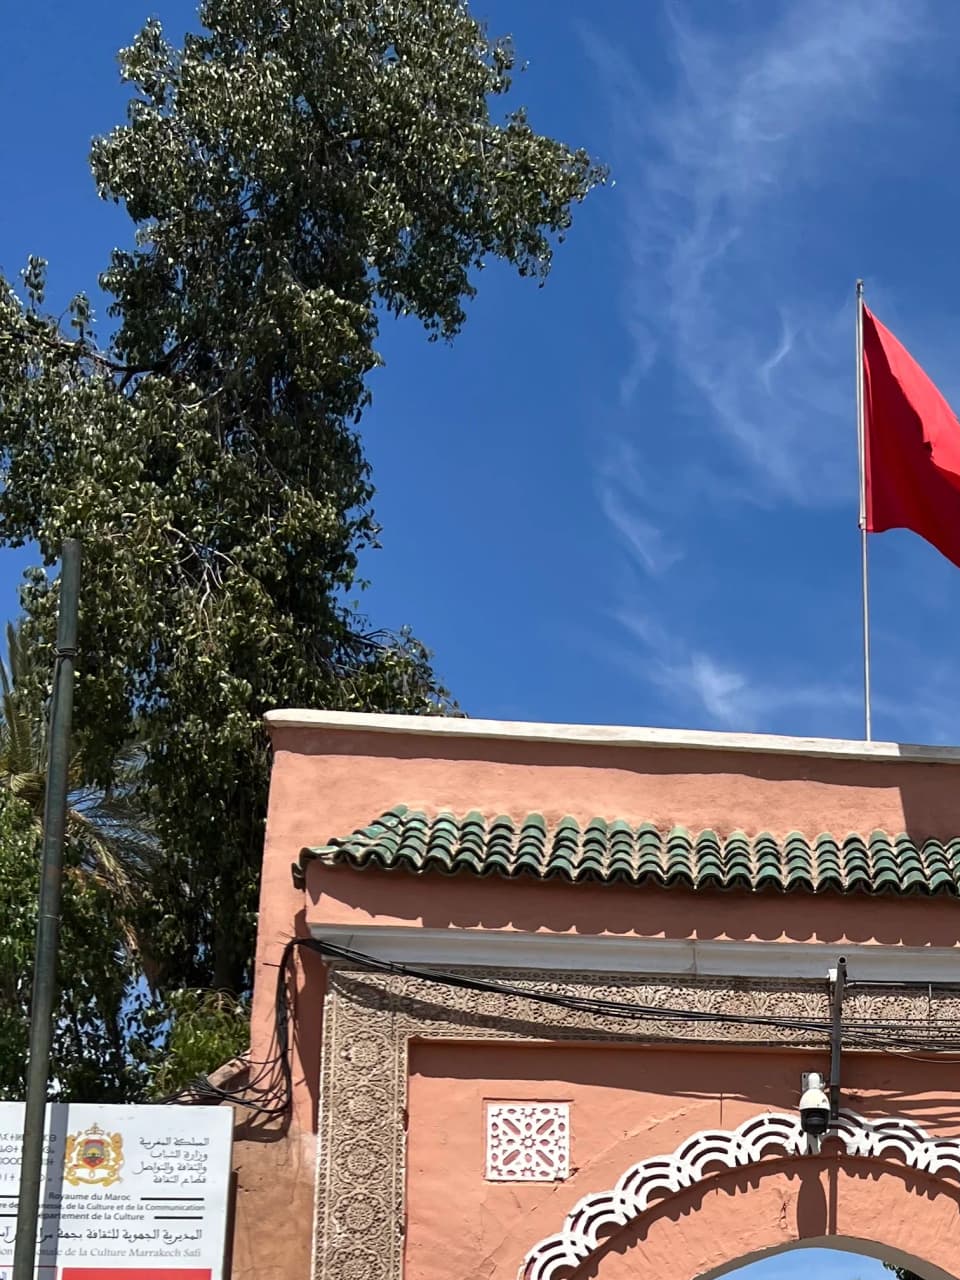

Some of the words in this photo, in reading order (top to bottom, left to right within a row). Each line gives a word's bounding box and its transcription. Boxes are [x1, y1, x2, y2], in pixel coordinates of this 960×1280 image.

[87, 1229, 119, 1239] للثقافة
[123, 1229, 160, 1243] الجهوية
[163, 1229, 202, 1245] المديرية
[65, 1248, 76, 1256] de
[79, 1248, 87, 1256] la
[90, 1248, 127, 1256] Culture
[128, 1248, 181, 1257] Marrakech
[183, 1248, 201, 1257] Safi
